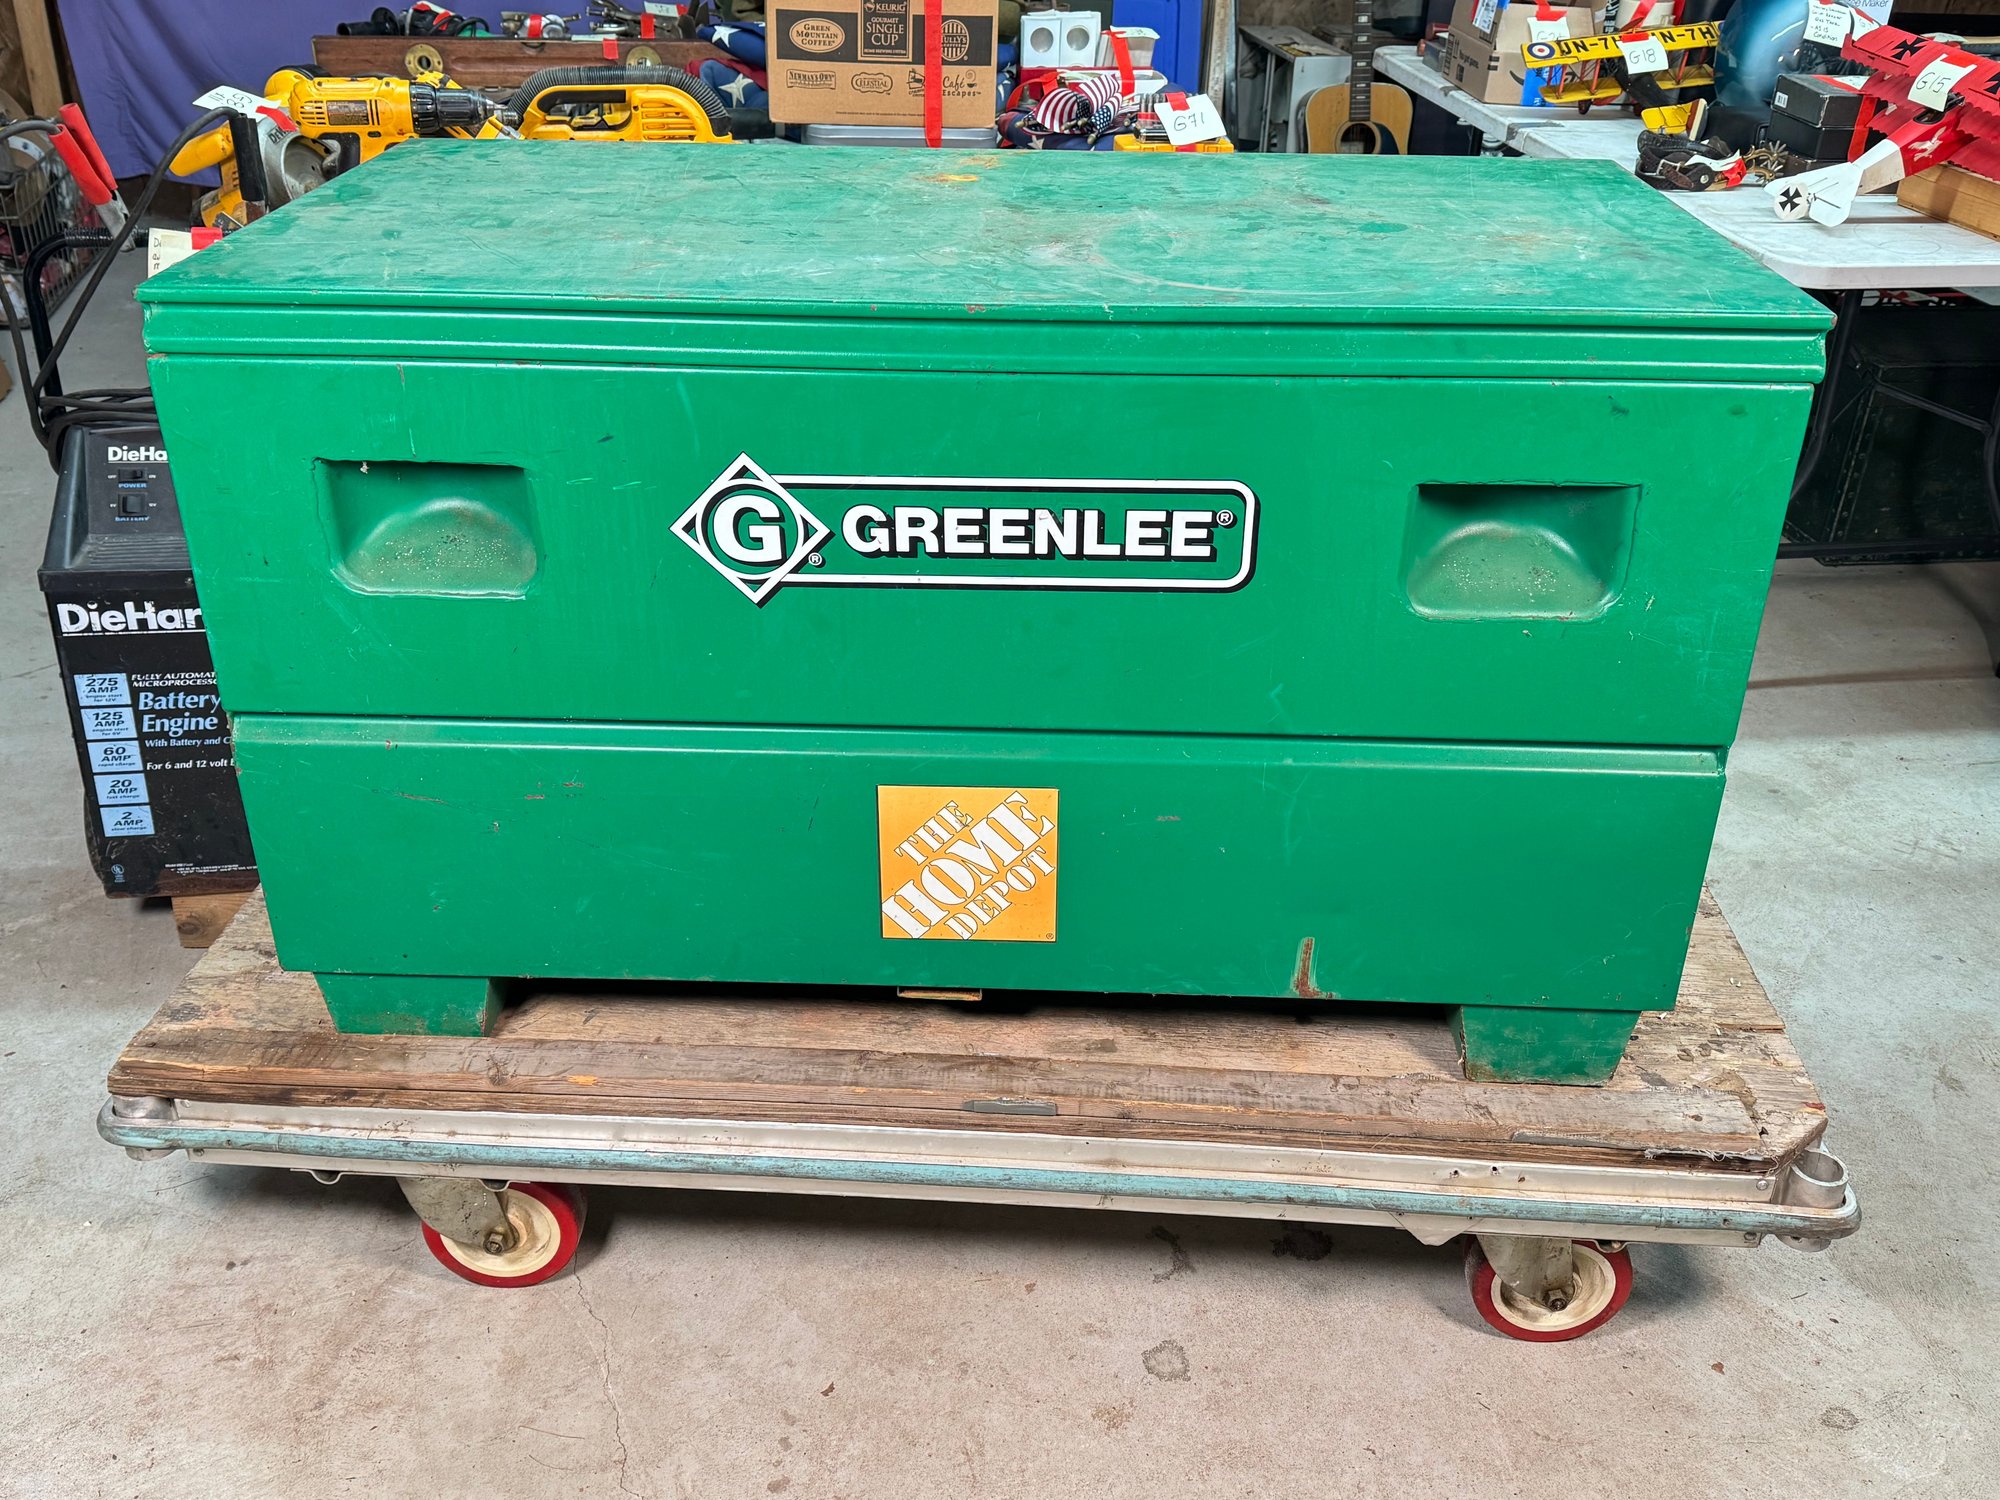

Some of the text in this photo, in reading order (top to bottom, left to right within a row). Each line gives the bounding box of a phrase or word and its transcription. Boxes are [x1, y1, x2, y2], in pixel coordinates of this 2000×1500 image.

[876, 3, 905, 12] KEURIG
[803, 23, 831, 32] GREEN
[866, 22, 904, 34] SINGLE
[801, 38, 835, 46] COFFEE
[871, 34, 899, 45] CUP
[1629, 48, 1656, 64] G18
[943, 75, 965, 91] Café
[1916, 72, 1952, 93] G15
[942, 90, 976, 98] Escapes
[1174, 112, 1205, 131] G71
[842, 504, 1215, 557] GREENLEE
[85, 677, 118, 687] 275
[138, 691, 220, 714] Battery
[92, 712, 123, 721] 125
[142, 711, 218, 737] Engine
[145, 739, 167, 747] With
[170, 738, 202, 747] Battery
[203, 737, 220, 745] and
[103, 747, 126, 755] 60
[174, 760, 192, 768] and
[210, 759, 228, 767] volt
[110, 779, 132, 788] 20
[121, 811, 133, 819] 2
[894, 800, 974, 866] THE
[881, 790, 1056, 939] HOME
[943, 845, 1056, 940] DEPOT
